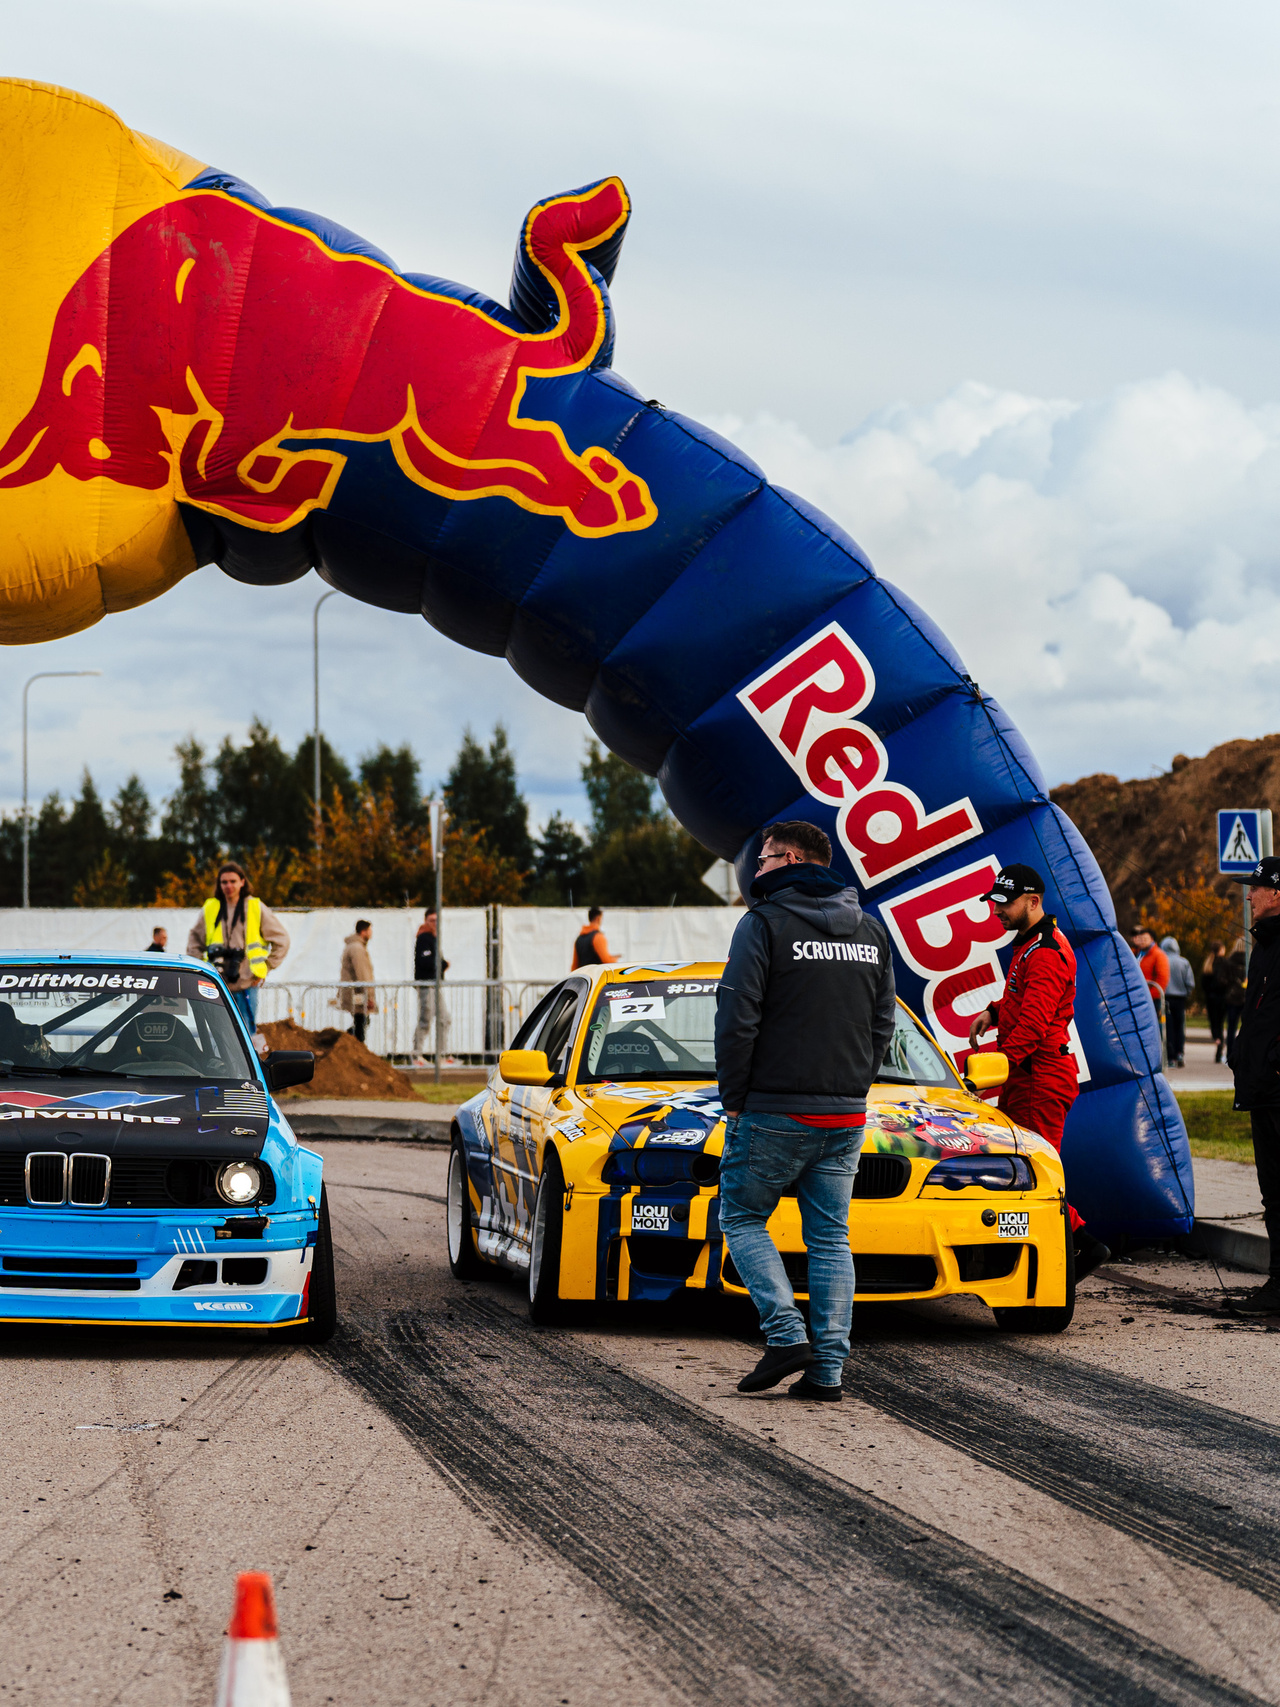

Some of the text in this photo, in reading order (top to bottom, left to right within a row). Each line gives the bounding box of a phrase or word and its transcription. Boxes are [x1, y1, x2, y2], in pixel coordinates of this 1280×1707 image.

[744, 628, 976, 882] Red
[792, 940, 879, 965] SCRUTINEER
[621, 1003, 654, 1014] 27
[143, 1025, 169, 1034] OMP
[633, 1205, 668, 1217] LIQUI
[633, 1218, 667, 1229] MOLY
[999, 1213, 1029, 1224] LIQUI
[999, 1225, 1029, 1237] MOLY
